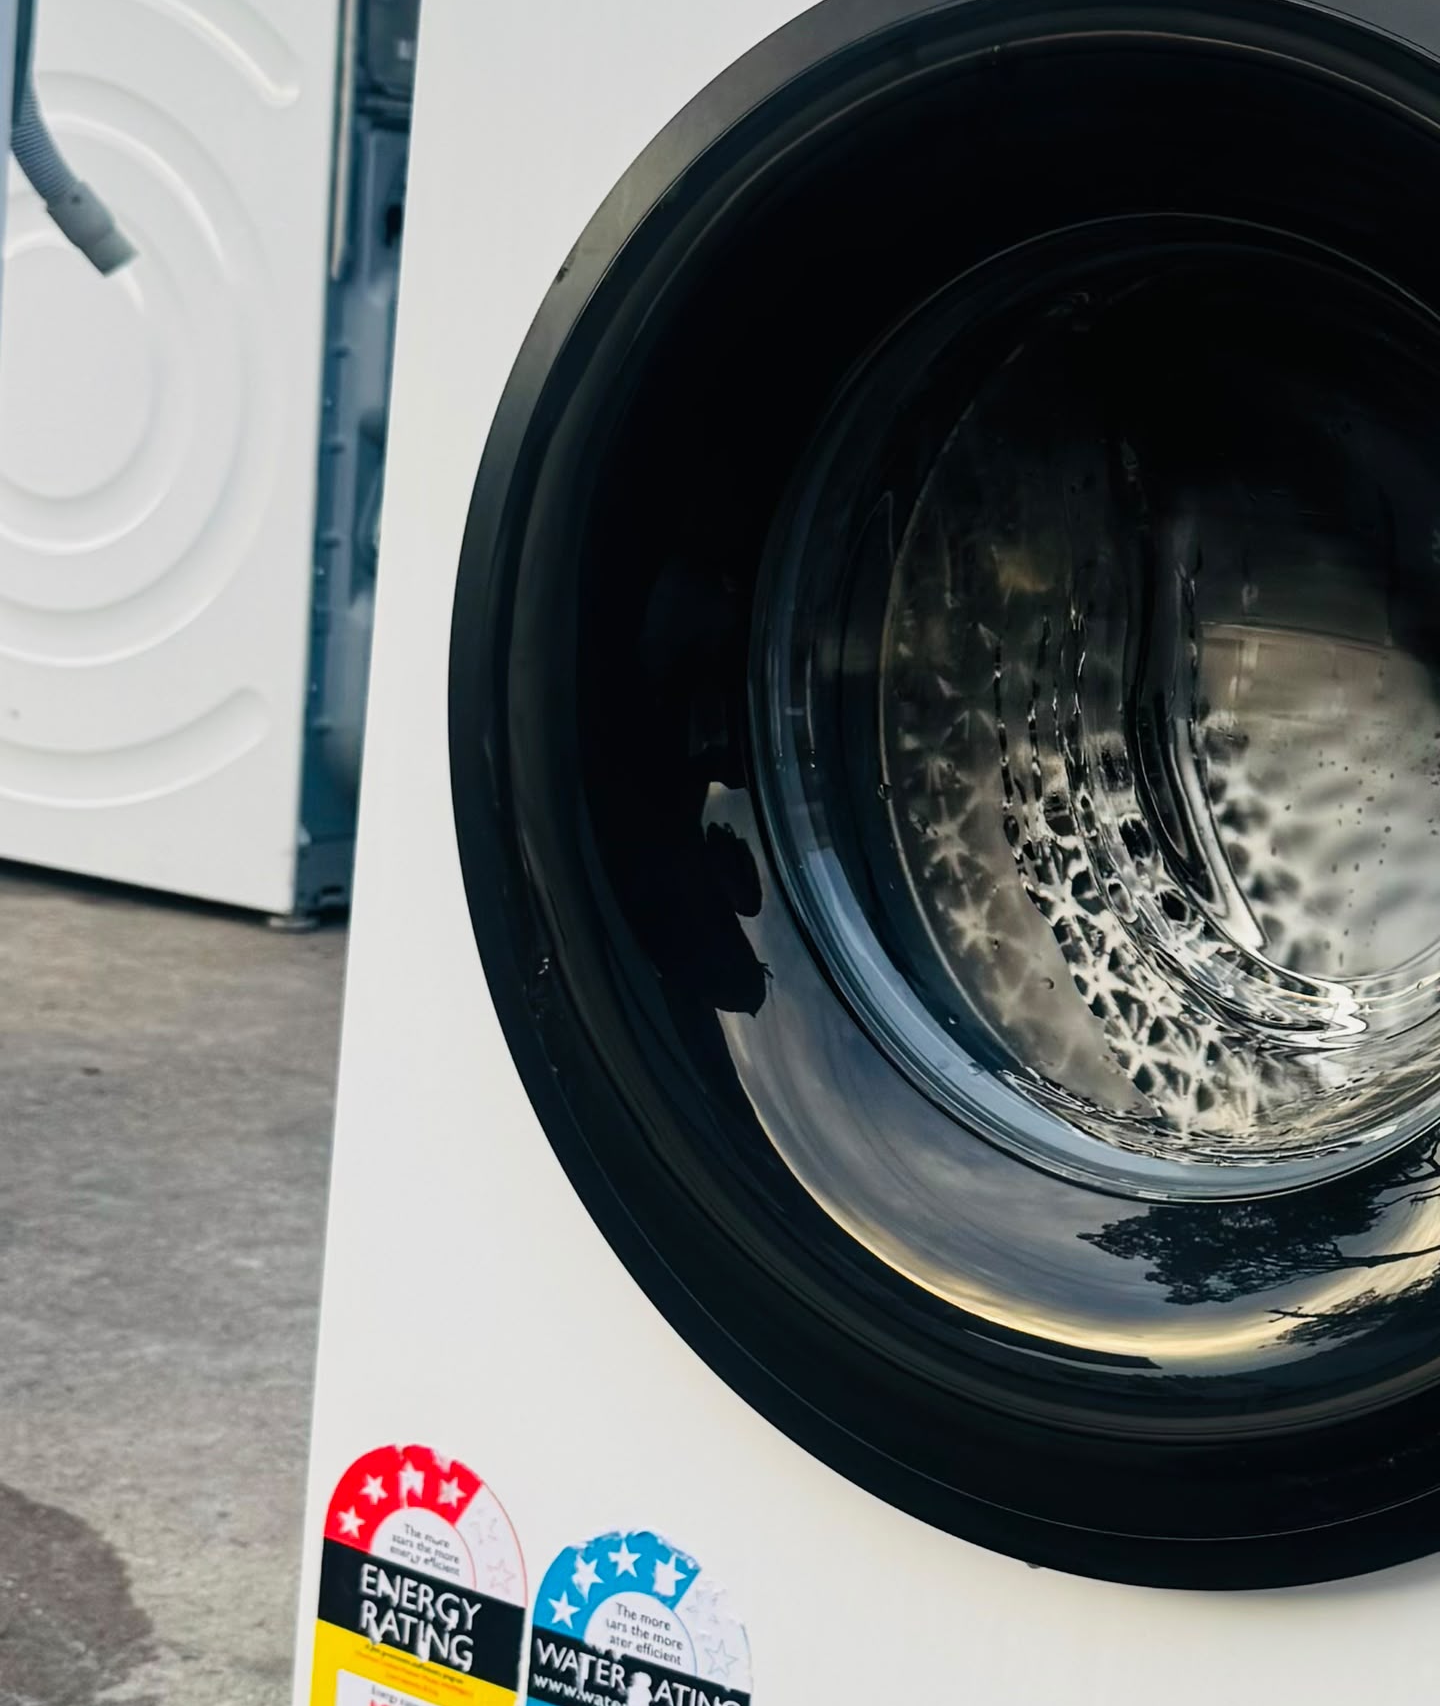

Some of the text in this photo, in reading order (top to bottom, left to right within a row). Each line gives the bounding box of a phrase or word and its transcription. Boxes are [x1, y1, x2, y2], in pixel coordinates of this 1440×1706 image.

[404, 1523, 450, 1549] The more
[434, 1548, 460, 1564] more
[360, 1562, 482, 1631] ENERGY
[616, 1602, 671, 1631] The more
[360, 1599, 474, 1673] RATING
[609, 1635, 682, 1666] ater efficient
[631, 1625, 650, 1640] the
[653, 1633, 683, 1650] more
[536, 1638, 628, 1693] WATER
